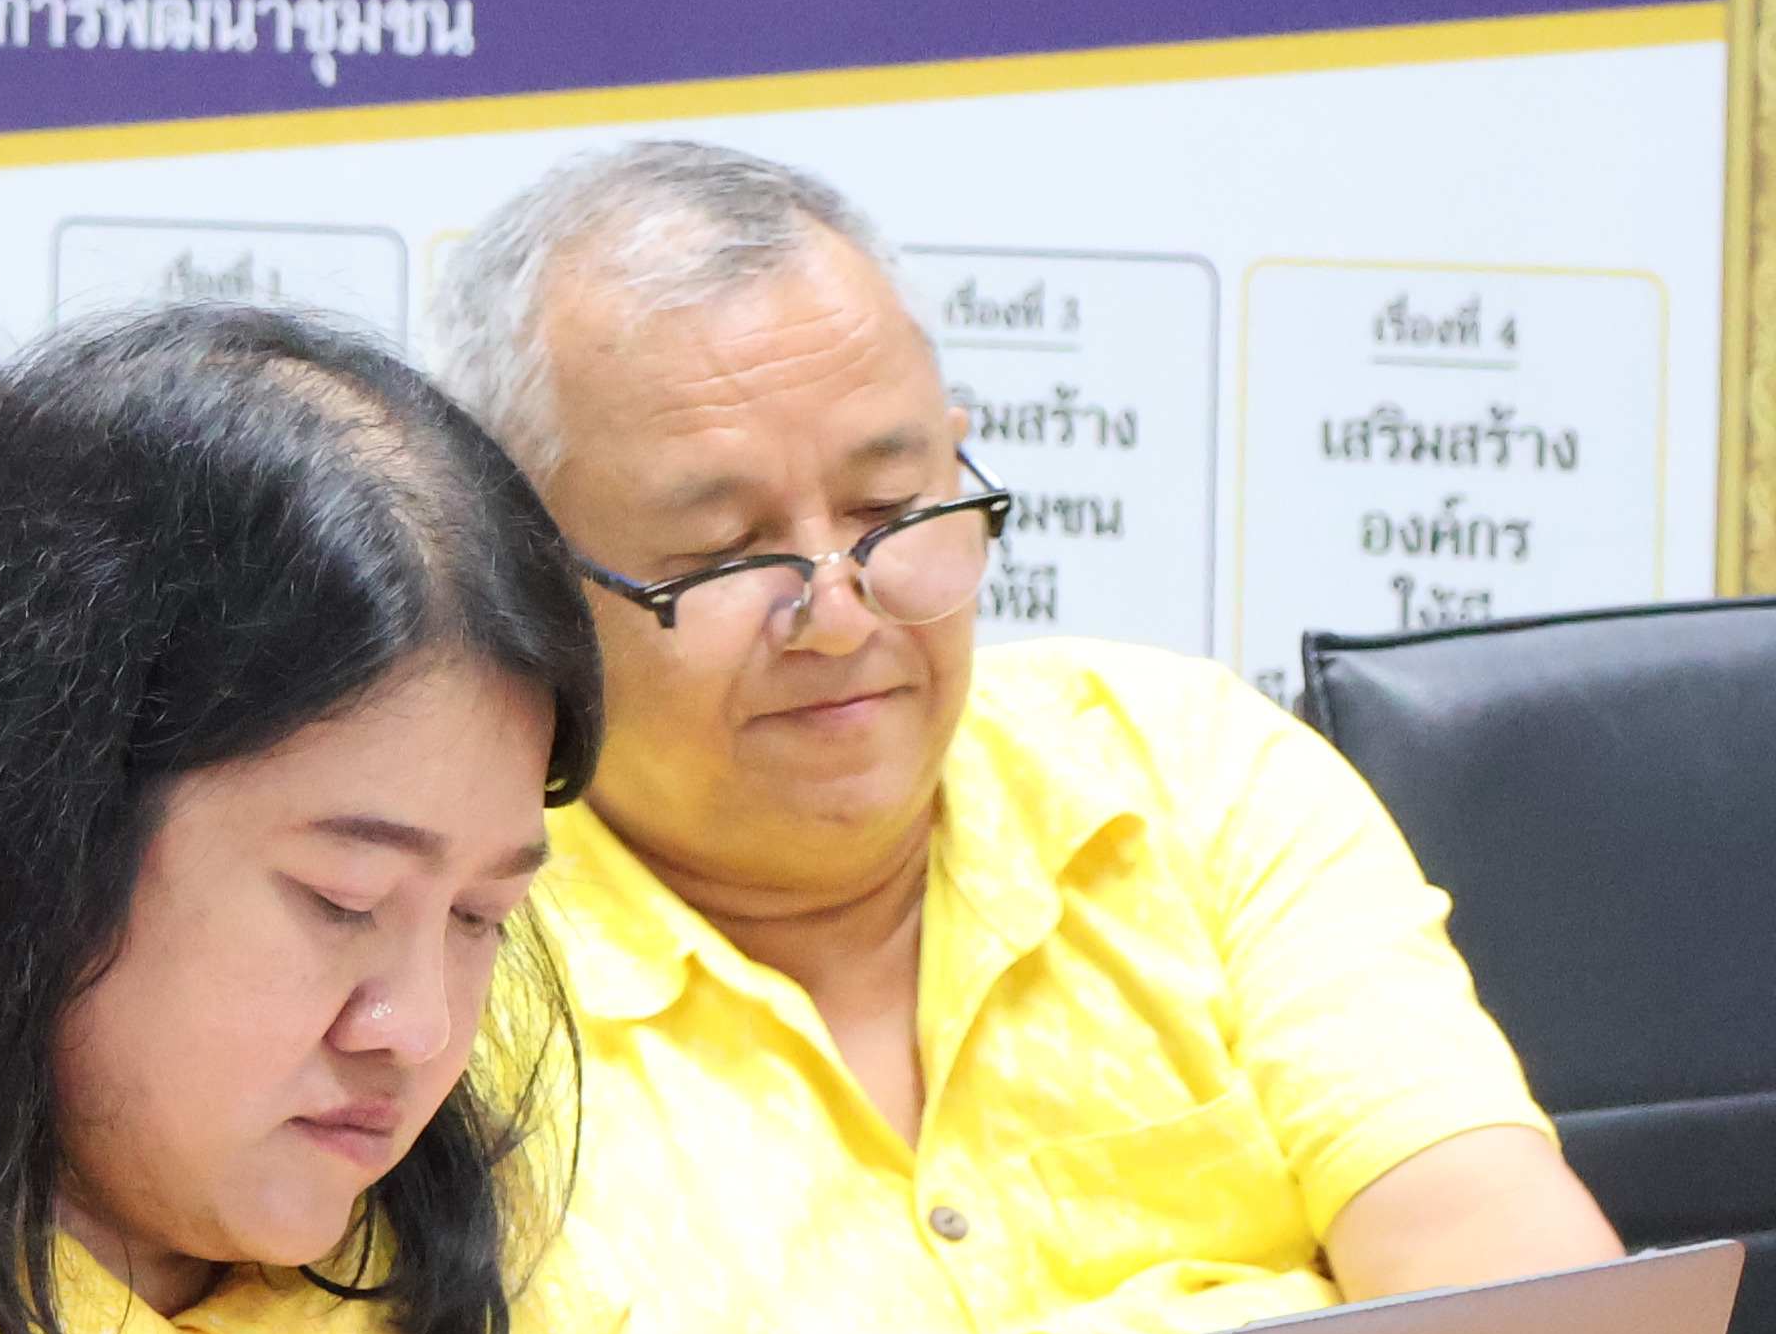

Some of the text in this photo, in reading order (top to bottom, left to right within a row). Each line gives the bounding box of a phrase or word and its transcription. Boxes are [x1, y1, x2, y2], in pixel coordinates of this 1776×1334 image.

[1320, 402, 1579, 472] เสริมสร้าง
[1361, 495, 1531, 559] องค์กร
